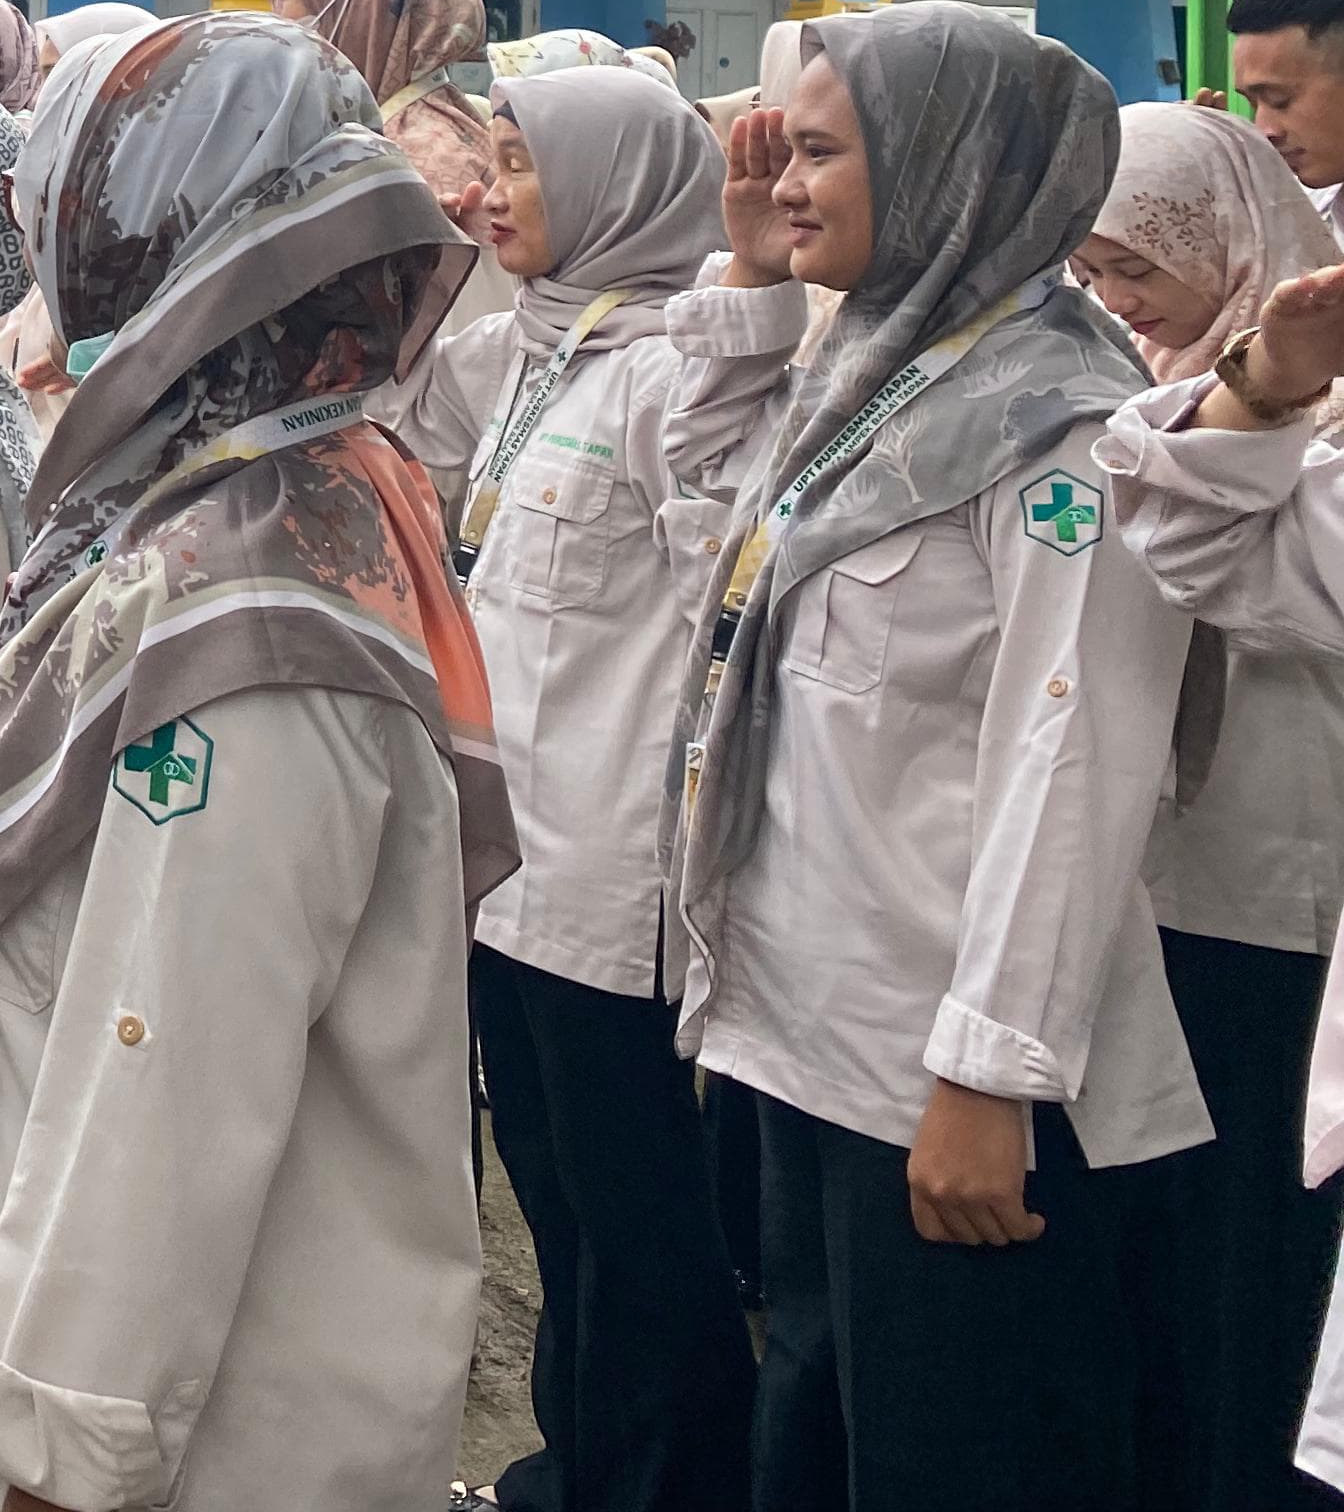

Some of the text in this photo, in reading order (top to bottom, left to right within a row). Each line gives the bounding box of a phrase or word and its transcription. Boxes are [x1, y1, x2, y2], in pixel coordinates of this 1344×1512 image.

[545, 370, 559, 392] UPT
[281, 400, 346, 433] KEKINIAN
[512, 389, 548, 451] PUSKESMAS
[792, 364, 922, 493] UPT PUSKESMAS TAPAN
[843, 374, 931, 458] AMPEK BALAI TAPAN
[494, 448, 517, 483] TAPAN
